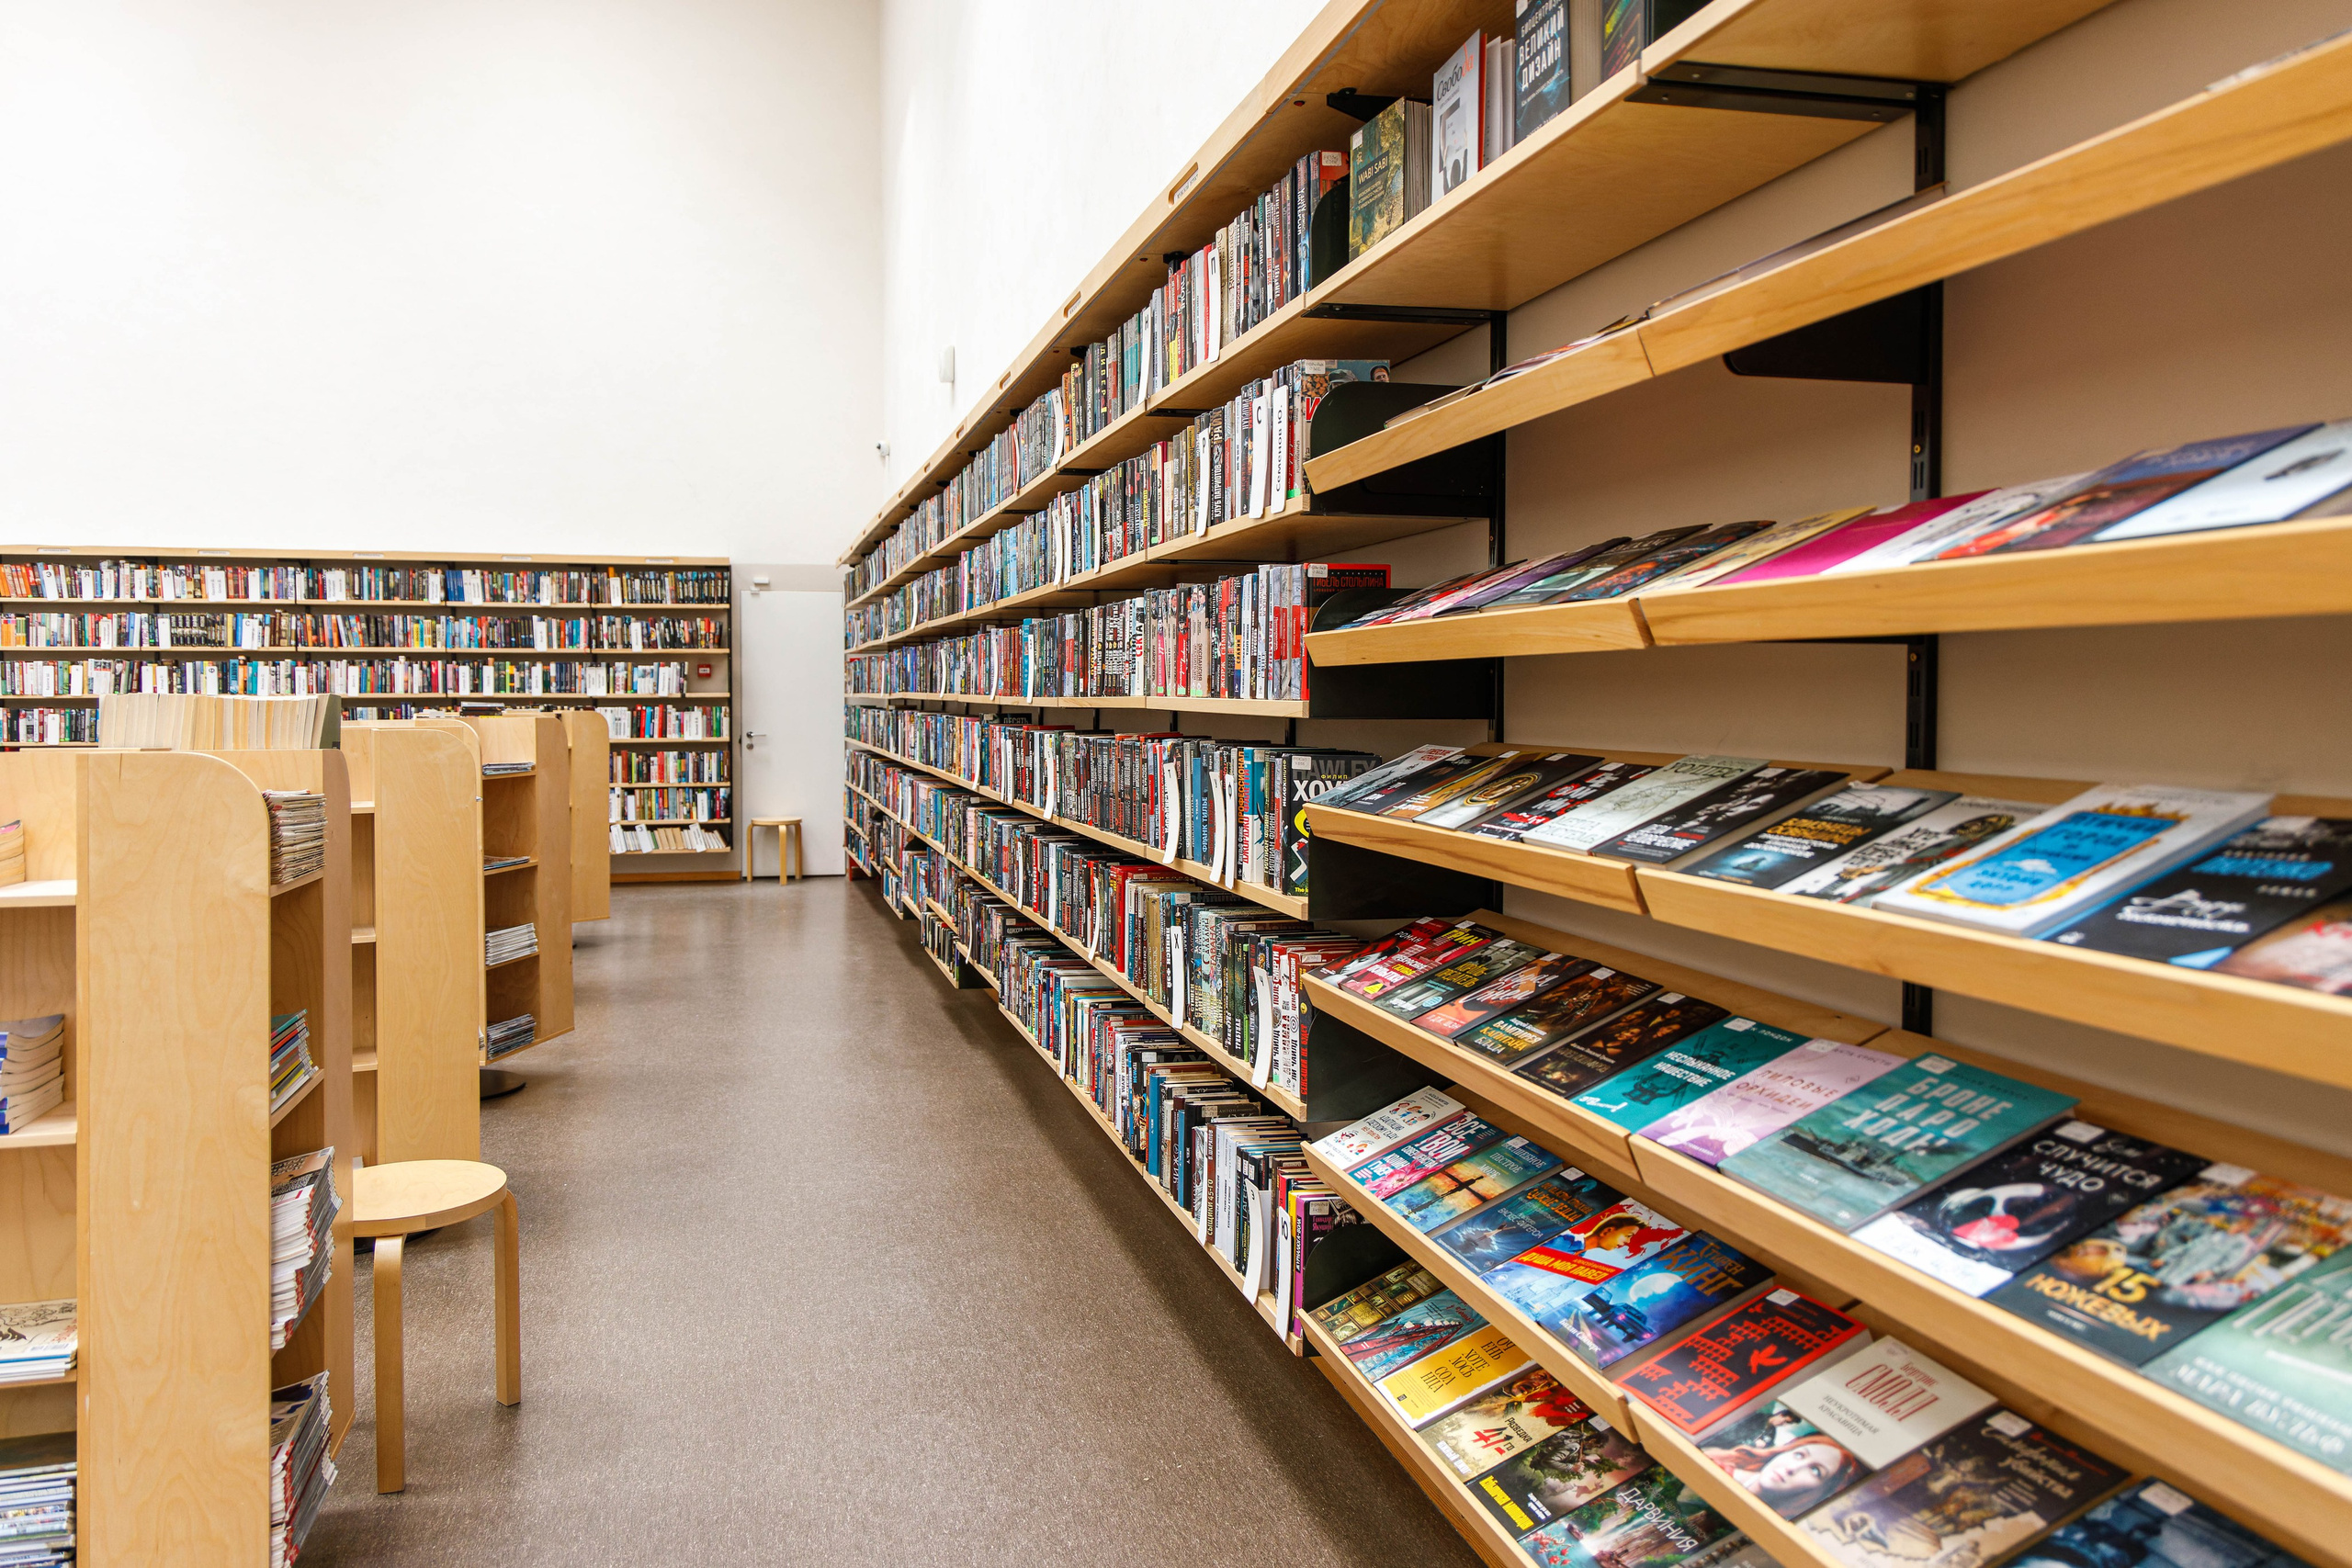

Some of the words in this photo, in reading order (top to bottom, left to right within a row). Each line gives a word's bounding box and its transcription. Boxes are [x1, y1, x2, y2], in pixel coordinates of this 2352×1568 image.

[1519, 5, 1564, 66] ВЕЛИКИЙ
[1521, 37, 1561, 92] ДИЗАЙН
[1358, 169, 1374, 186] WABI
[1374, 156, 1388, 175] SABI
[1275, 428, 1283, 492] Семенов
[1340, 577, 1385, 588] СТОЛЫПИНА
[1440, 928, 1484, 947] ГРИН
[1432, 967, 1483, 988] ПРЕДАТЕЛЬ
[1472, 1035, 1509, 1055] БЛАДА
[1477, 1025, 1531, 1053] КАПИТАНА
[1489, 1019, 1543, 1045] ВАМПИРЕЯ
[1273, 1058, 1279, 1070] ЛИ
[1301, 1047, 1307, 1056] НЕ
[1660, 1050, 1737, 1081] НЕСЛЫХАННОЕ
[1291, 1071, 1297, 1081] ЛИ
[1649, 1061, 1713, 1089] НАШЕСТВИЕ
[1752, 1069, 1843, 1099] ЛИЛОВЫЕ
[1730, 1080, 1818, 1111] ОРХИДЕИ
[1901, 1076, 2016, 1121] БРОНЕ
[1364, 1119, 1388, 1134] ДЕТСКОМУ
[1381, 1130, 1398, 1141] САДУ
[1442, 1116, 1487, 1140] ВСЕ
[1870, 1092, 1983, 1139] ПАРО
[1411, 1130, 1470, 1163] ТВОИ
[1838, 1109, 1951, 1157] ХОДЫ
[1476, 1163, 1501, 1179] МОРЕ
[1487, 1151, 1524, 1173] ПЕСТРОЕ
[2019, 1136, 2171, 1191] СЛУЧИТСЯ
[2024, 1158, 2115, 1195] ЧУДО
[1496, 1206, 1546, 1239] ВАСКЕС-ФИГЕРОА
[1521, 1252, 1550, 1269] ДУША
[1555, 1262, 1573, 1276] МОЯ
[1575, 1267, 1610, 1282] ПАВЕЛ
[1651, 1244, 1748, 1302] КИНГ
[2084, 1265, 2170, 1307] 15
[2015, 1270, 2180, 1344] НОЖЕВЫХ
[1478, 1340, 1507, 1360] ЕНЬ
[1494, 1336, 1517, 1350] ОЧ
[1556, 1317, 1582, 1335] Билли
[1572, 1330, 1605, 1353] Саммерс
[1431, 1364, 1458, 1384] СОЛ
[1446, 1354, 1478, 1378] ЛОСЬ
[1458, 1348, 1492, 1371] ХОТЕ
[1418, 1371, 1446, 1393] НЦА
[1841, 1361, 1942, 1423] СМОЛЛ
[1815, 1404, 1864, 1437] КРАСАВИЦА
[1821, 1394, 1880, 1434] НЕУКРОТИМАЯ
[1465, 1418, 1518, 1453] 41
[1500, 1441, 1516, 1451] ГО
[1502, 1416, 1536, 1443] РАЗВЕДКА
[1614, 1484, 1703, 1553] ДАРВИНИЯ
